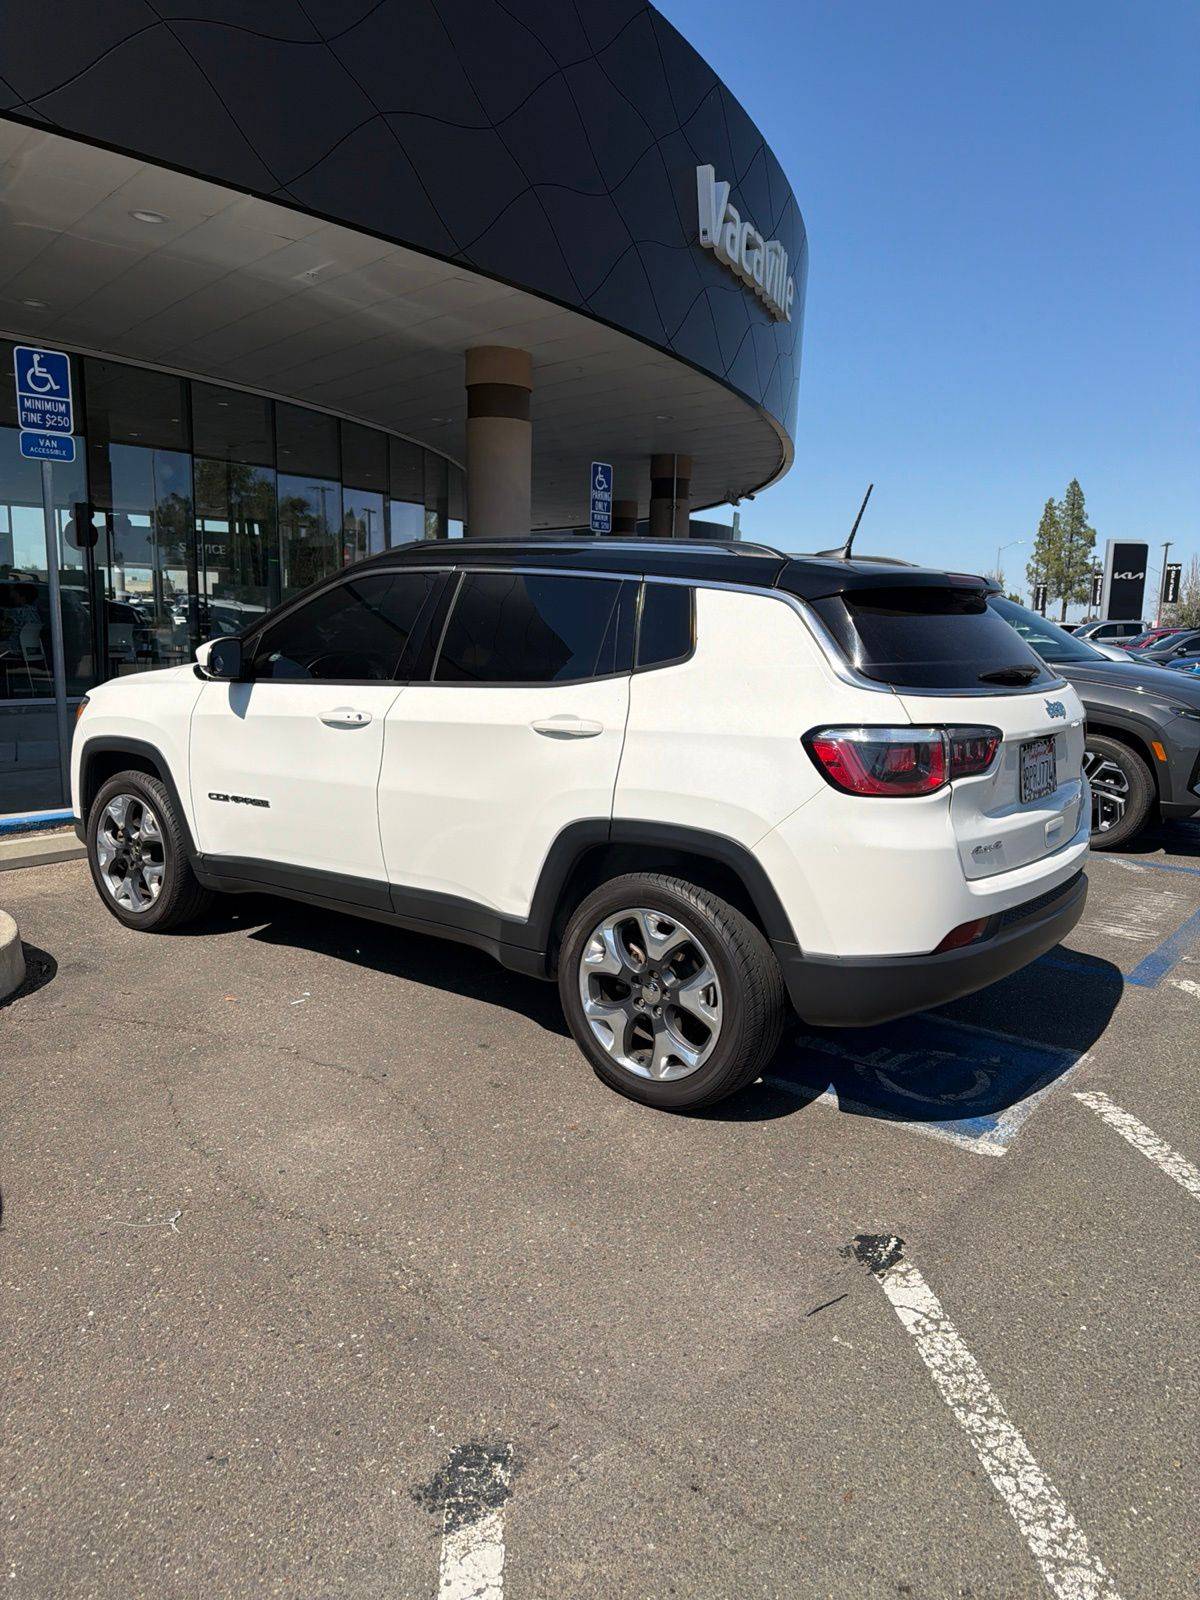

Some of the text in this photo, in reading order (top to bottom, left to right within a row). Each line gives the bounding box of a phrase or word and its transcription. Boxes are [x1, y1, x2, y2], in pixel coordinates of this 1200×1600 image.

[24, 397, 66, 413] MINIMUM
[22, 411, 70, 428] FINE $250
[38, 438, 58, 448] VAN
[29, 446, 67, 457] ACCESSIBLE
[592, 489, 611, 502] PARKING
[594, 501, 608, 512] ONLY
